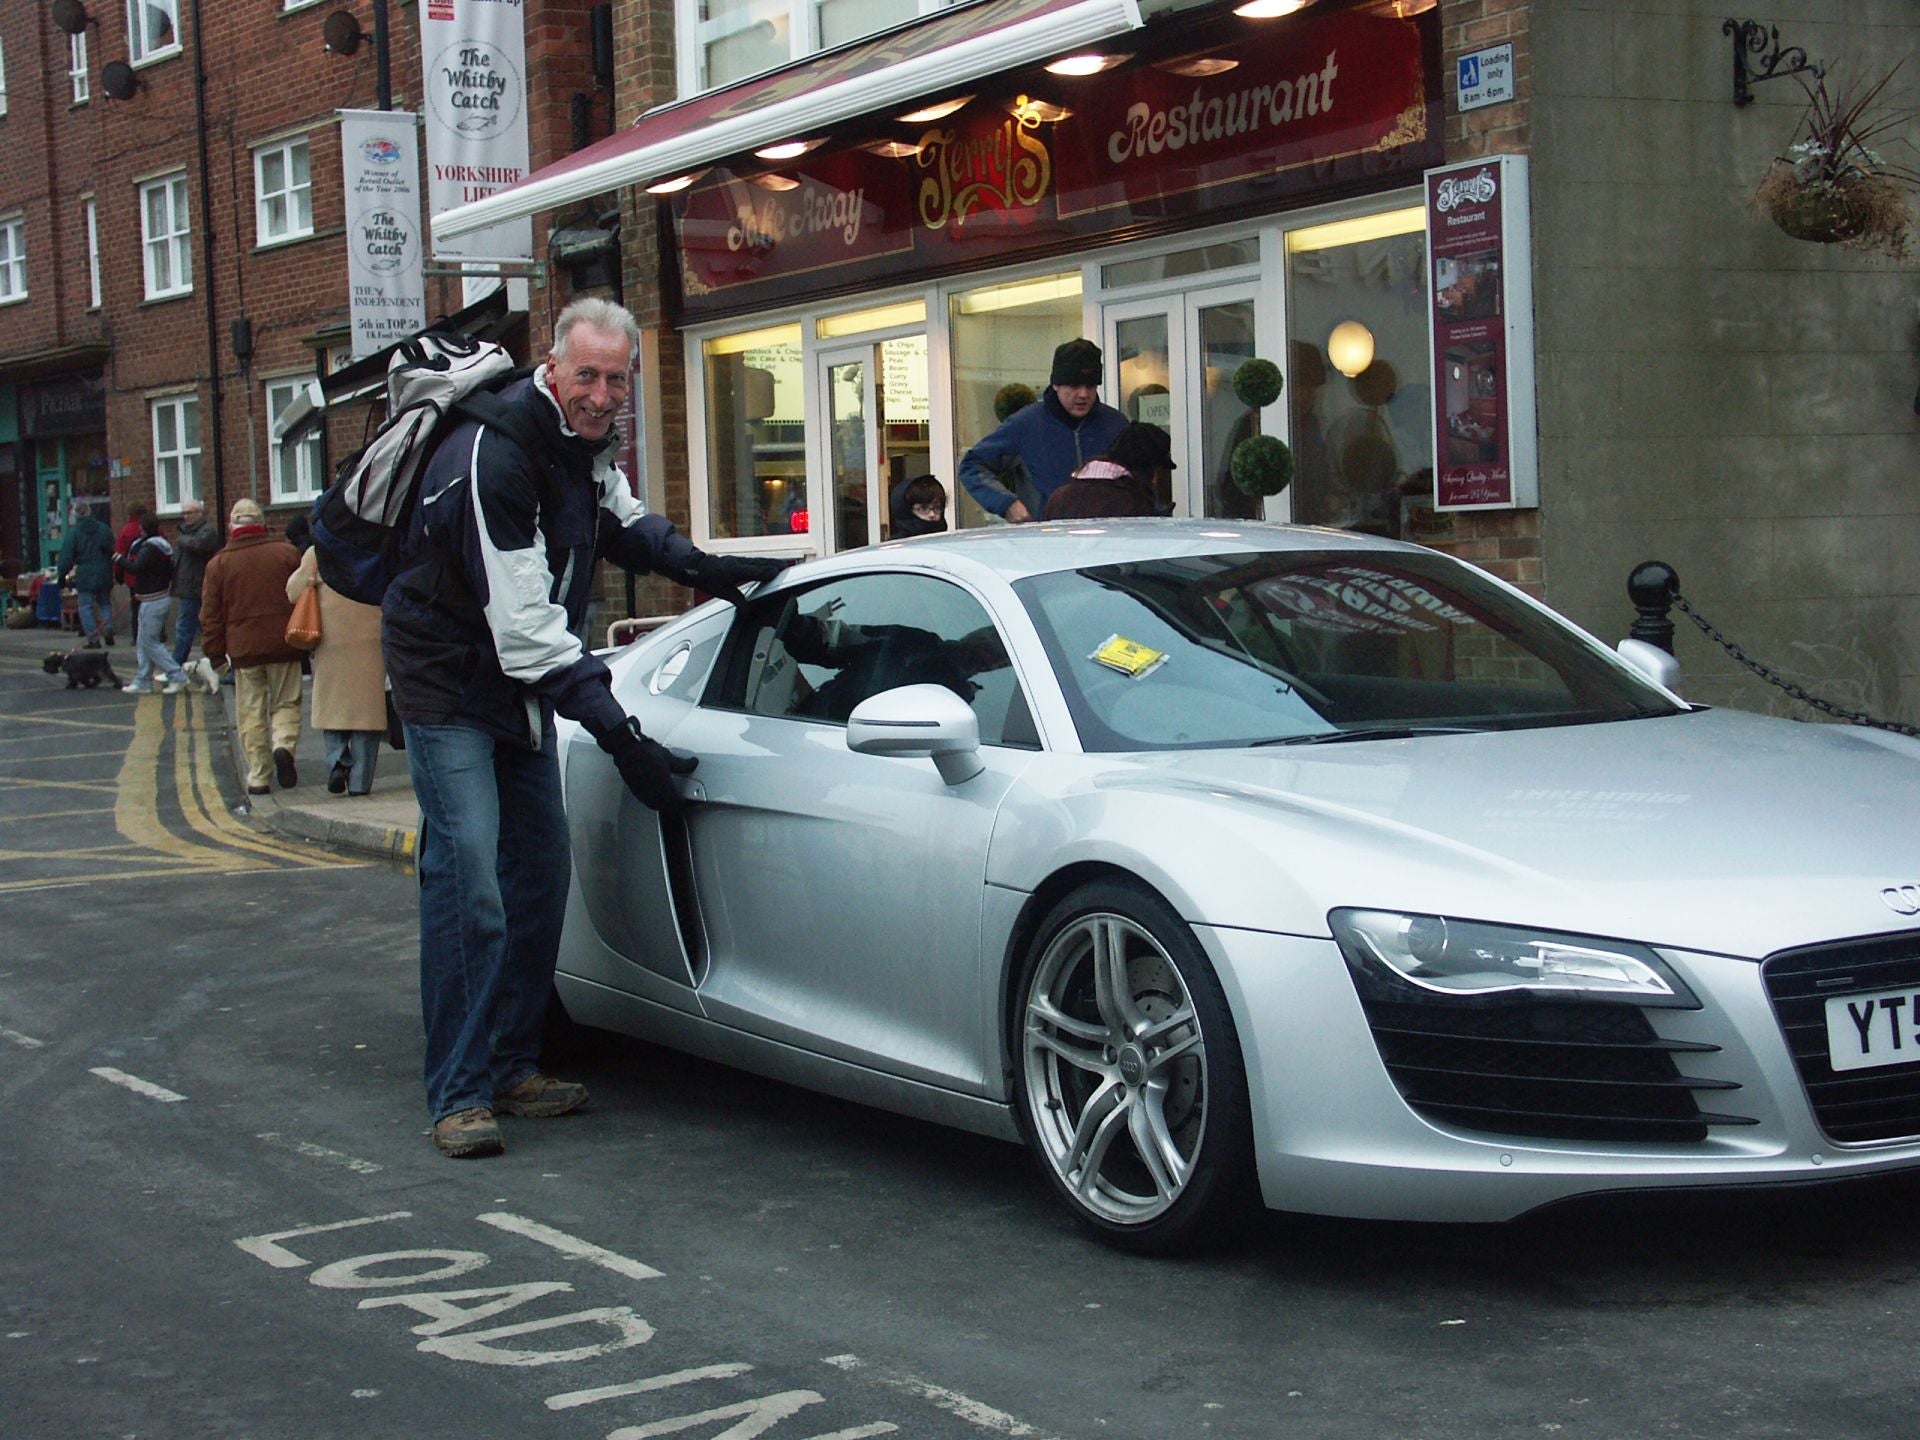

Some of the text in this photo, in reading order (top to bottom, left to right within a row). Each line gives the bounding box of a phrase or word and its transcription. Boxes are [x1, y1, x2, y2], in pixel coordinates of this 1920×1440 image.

[459, 47, 490, 67] The
[1481, 53, 1510, 67] Loading
[1487, 67, 1504, 79] only
[442, 67, 506, 96] Whitby
[451, 91, 499, 111] Catch
[1107, 49, 1339, 164] Restaurant
[372, 212, 395, 226] The
[788, 186, 865, 246] Away
[1446, 211, 1486, 226] Restaurant
[361, 226, 407, 246] Whitby
[367, 242, 402, 256] Catch
[354, 286, 373, 295] THE
[354, 297, 421, 307] INDEPENDENT
[358, 318, 373, 329] 5th
[376, 318, 384, 329] in
[386, 318, 407, 329] TOP
[1147, 405, 1169, 417] OPEN
